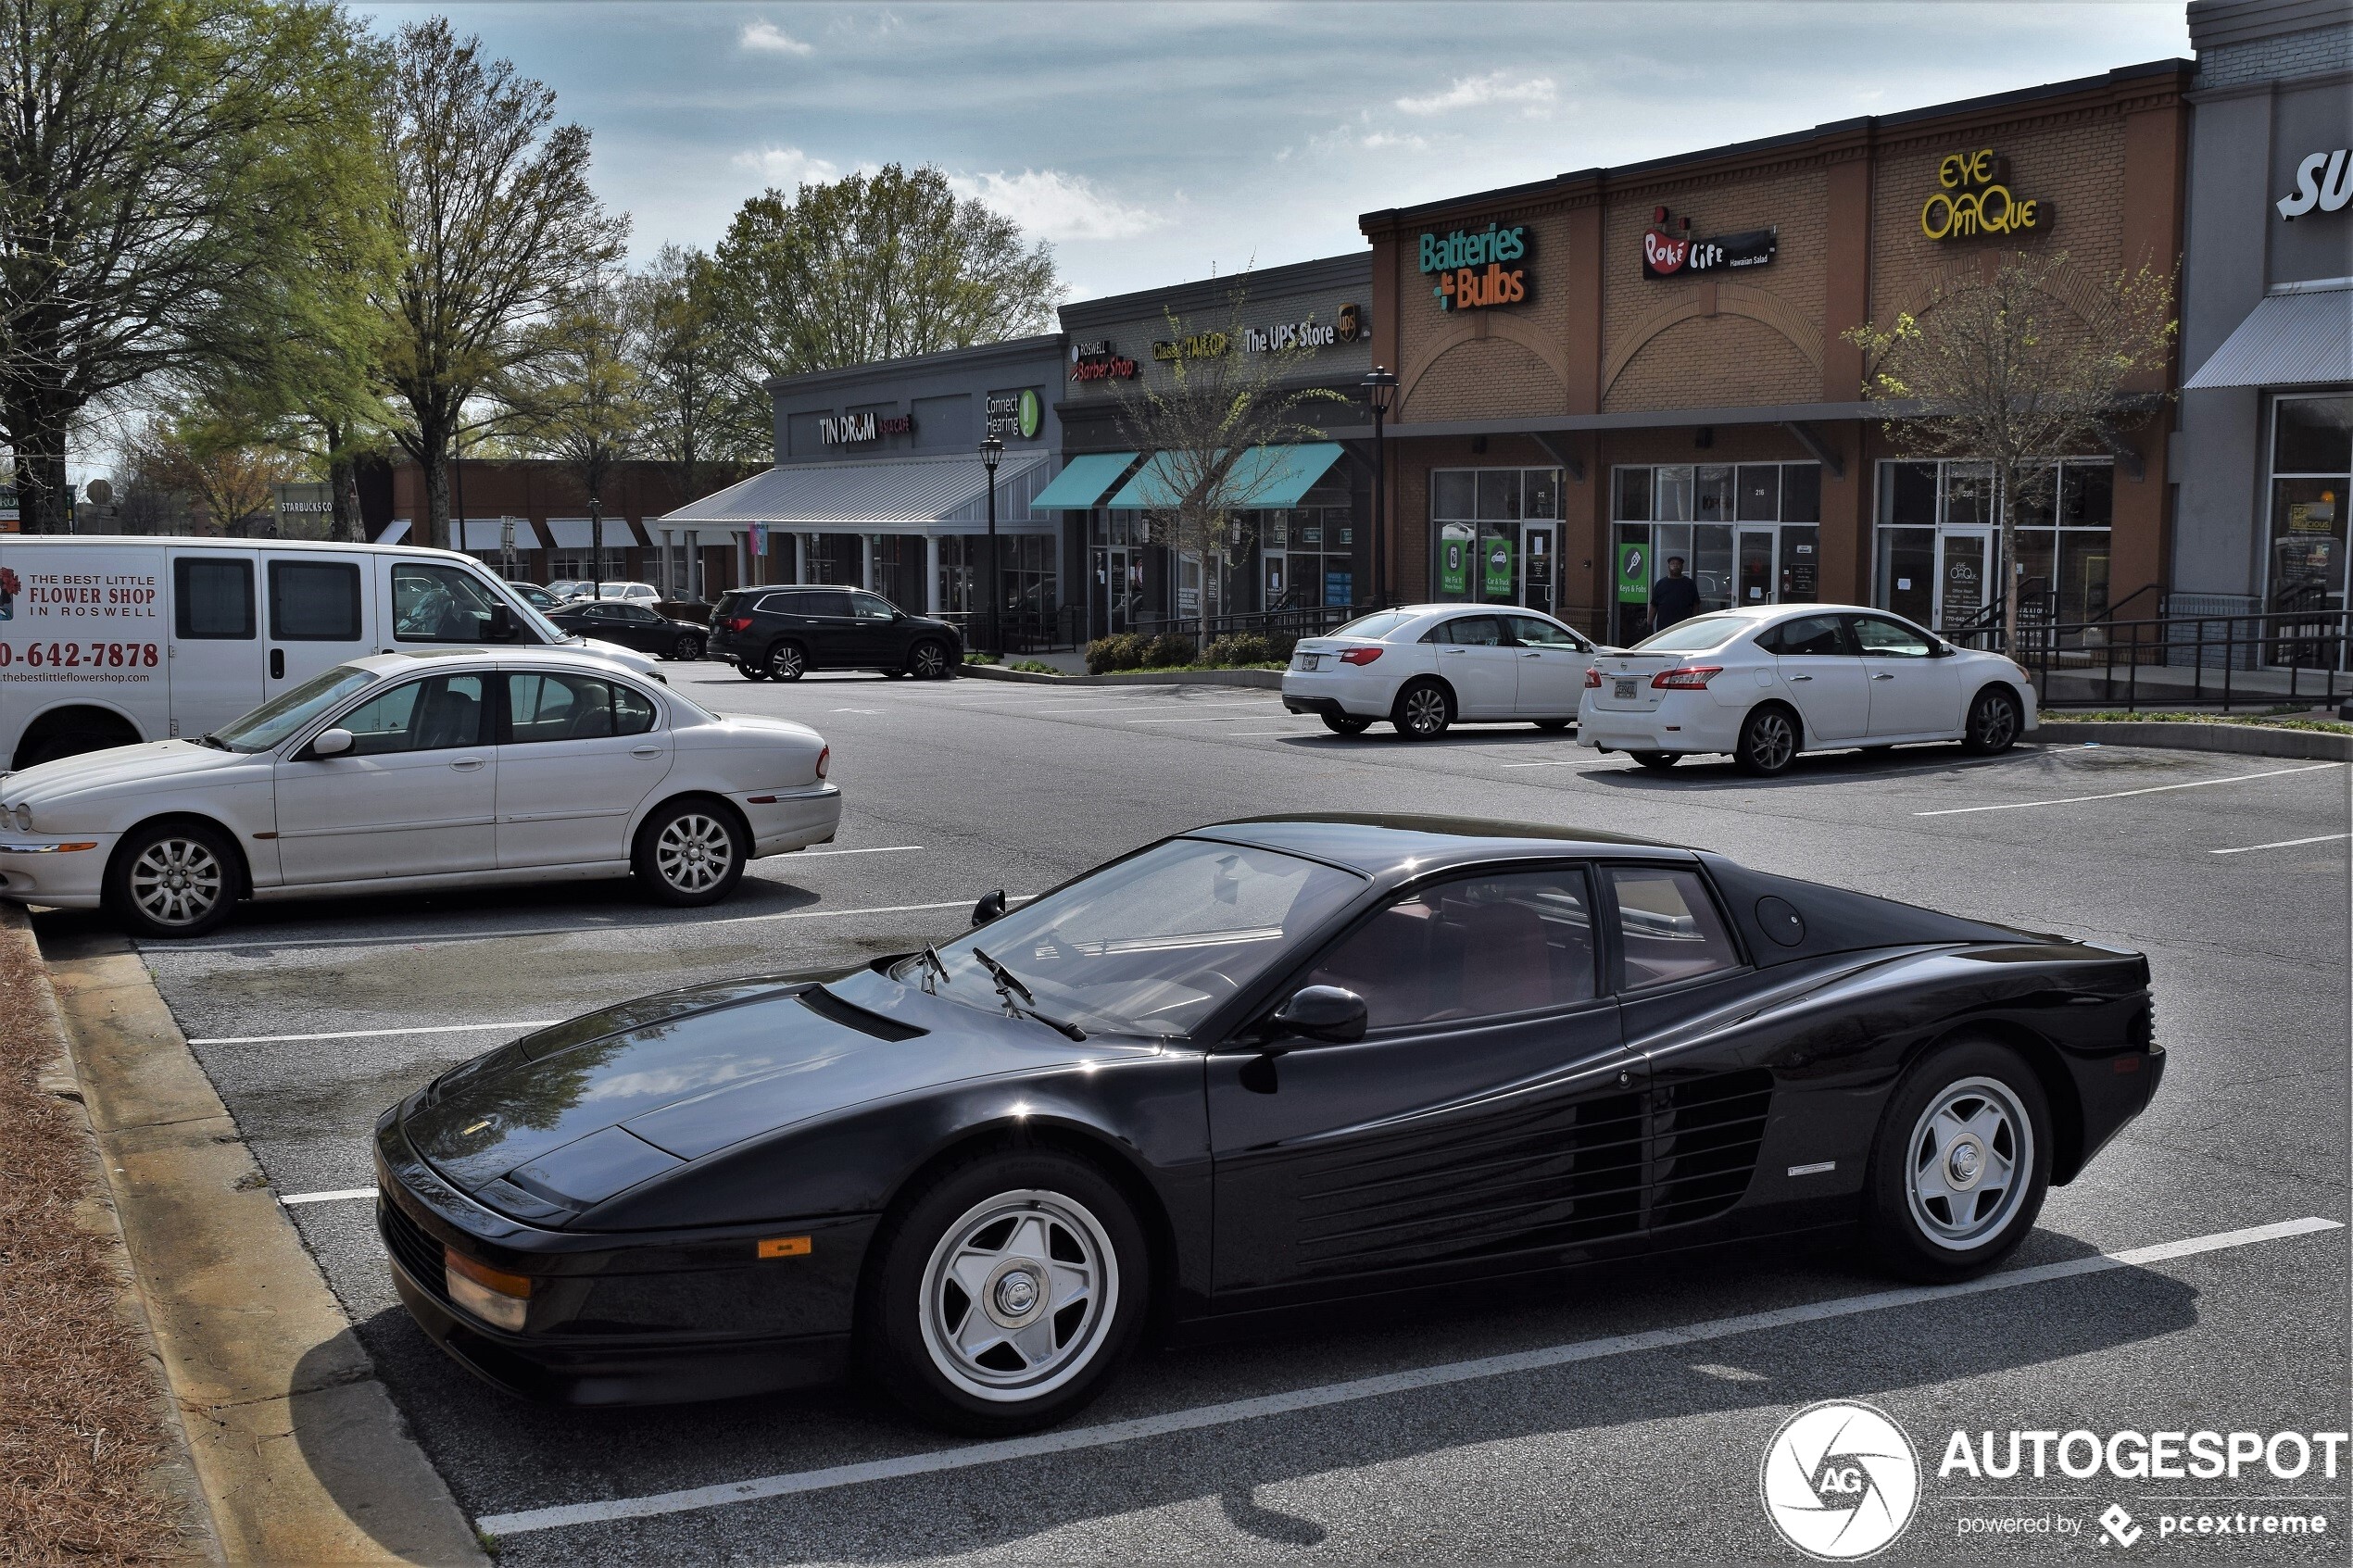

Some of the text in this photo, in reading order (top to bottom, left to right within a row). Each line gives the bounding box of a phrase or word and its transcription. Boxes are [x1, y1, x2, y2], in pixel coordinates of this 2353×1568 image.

[1940, 149, 1993, 188] EYE
[1419, 223, 1524, 273] Batteries
[1754, 255, 1768, 265] Salad
[1457, 263, 1524, 308] Bulbs
[1244, 320, 1334, 352] The UPS Store
[1079, 341, 1105, 357] ROSWELL
[1078, 357, 1133, 383] Barber Shop
[986, 394, 1018, 414] Connect
[819, 418, 838, 445] TIN
[840, 412, 876, 443] DRUM
[986, 414, 1019, 435] Hearing
[282, 502, 333, 512] STARBUCKS CO
[30, 574, 156, 585] THE BEST LITTLE
[1619, 584, 1647, 594] Keys & Fobs
[30, 587, 156, 604] FLOWER SHOP
[30, 607, 156, 617] IN ROSWELL
[0, 642, 158, 668] 0-642-7878
